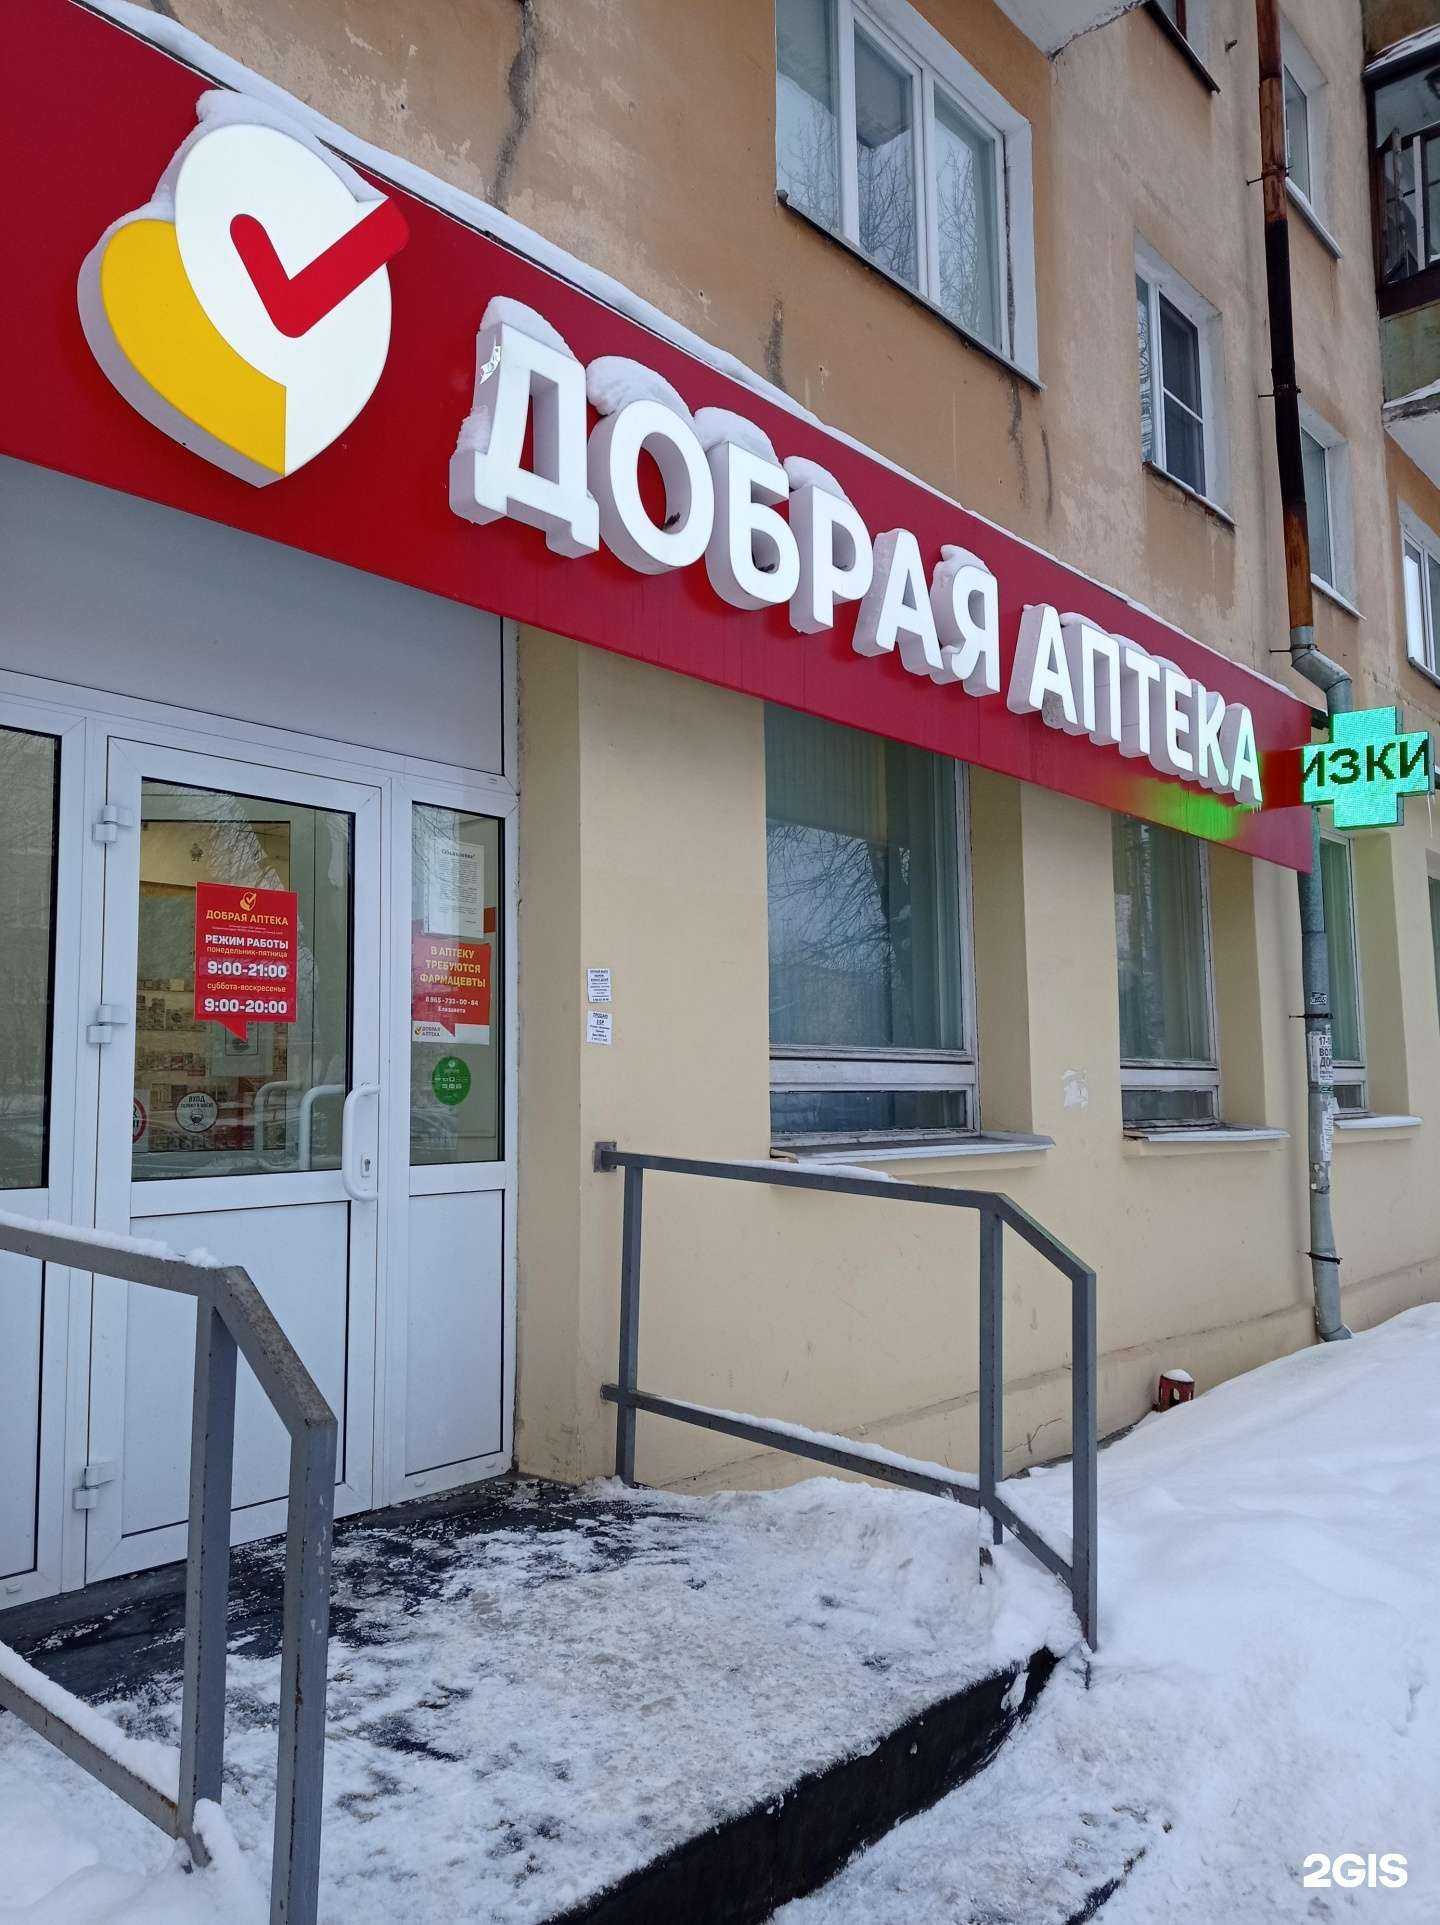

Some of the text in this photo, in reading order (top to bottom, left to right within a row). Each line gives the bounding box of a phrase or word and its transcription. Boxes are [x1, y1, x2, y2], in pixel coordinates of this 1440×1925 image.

[452, 320, 1264, 804] ДОБРАЯ АПТЕКА
[206, 909, 289, 926] ДОБРАЯ АПТЕКА
[205, 934, 289, 950] РЕЖИМ РАБОТЫ
[206, 946, 288, 958] понедельник-пятница
[431, 946, 475, 959] В АПТЕКУ
[207, 960, 287, 978] 9:00-21:00
[425, 960, 481, 974] ТРЕБУЮТСЯ
[207, 981, 287, 993] суббота-воскресенье
[420, 972, 486, 988] ФАРМАЦЕВТЫ
[204, 998, 288, 1014] 9:00-20:00
